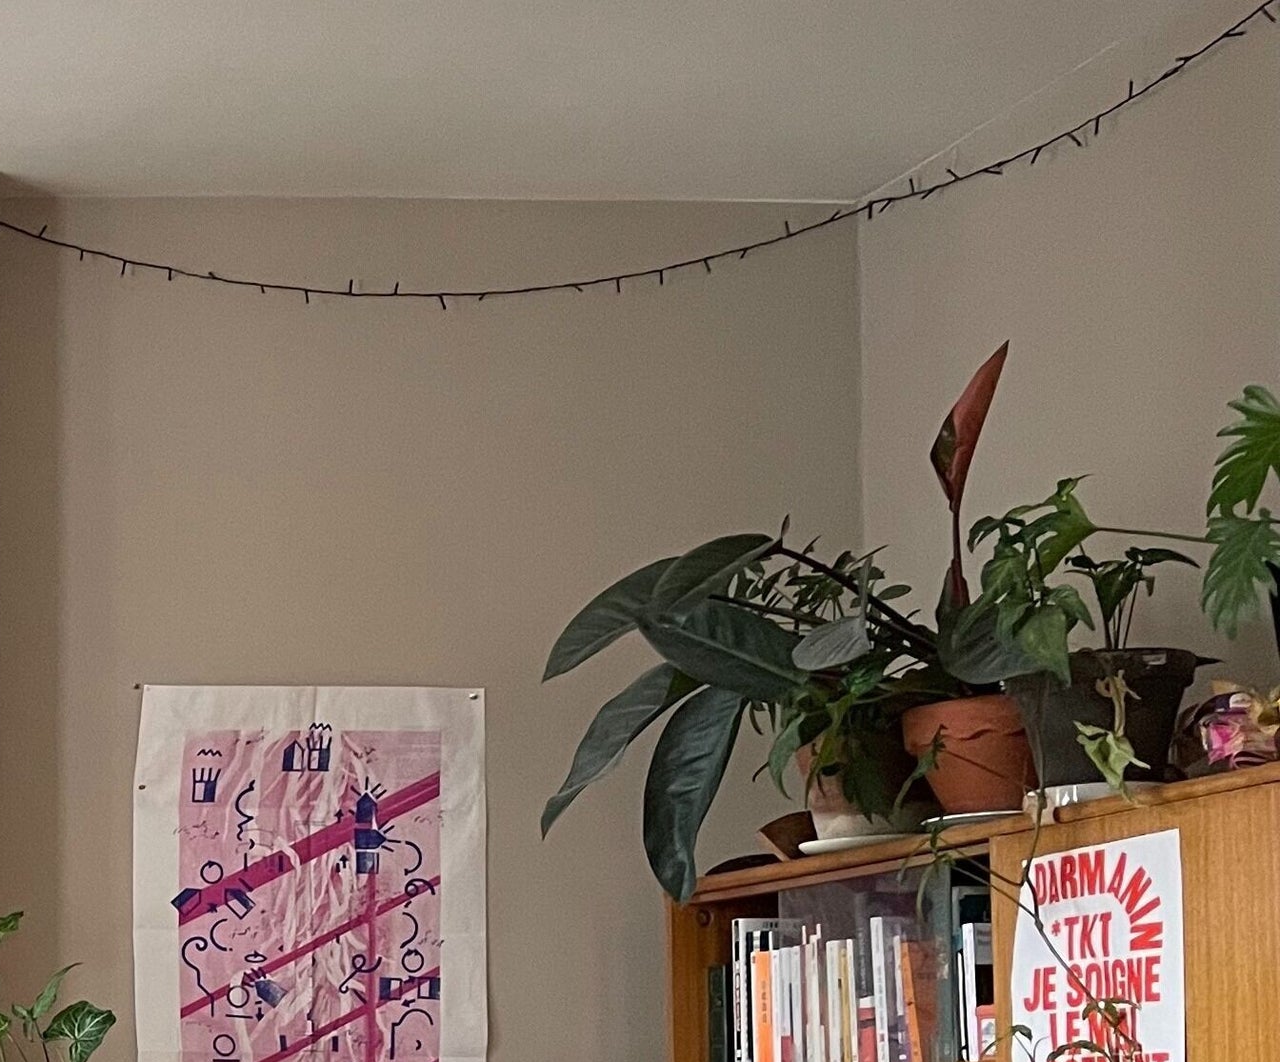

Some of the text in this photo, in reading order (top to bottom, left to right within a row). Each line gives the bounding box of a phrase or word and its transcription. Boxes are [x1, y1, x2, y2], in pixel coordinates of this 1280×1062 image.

[1034, 849, 1163, 951] DARMANIN
[1023, 955, 1161, 1012] JE SOIGNE
